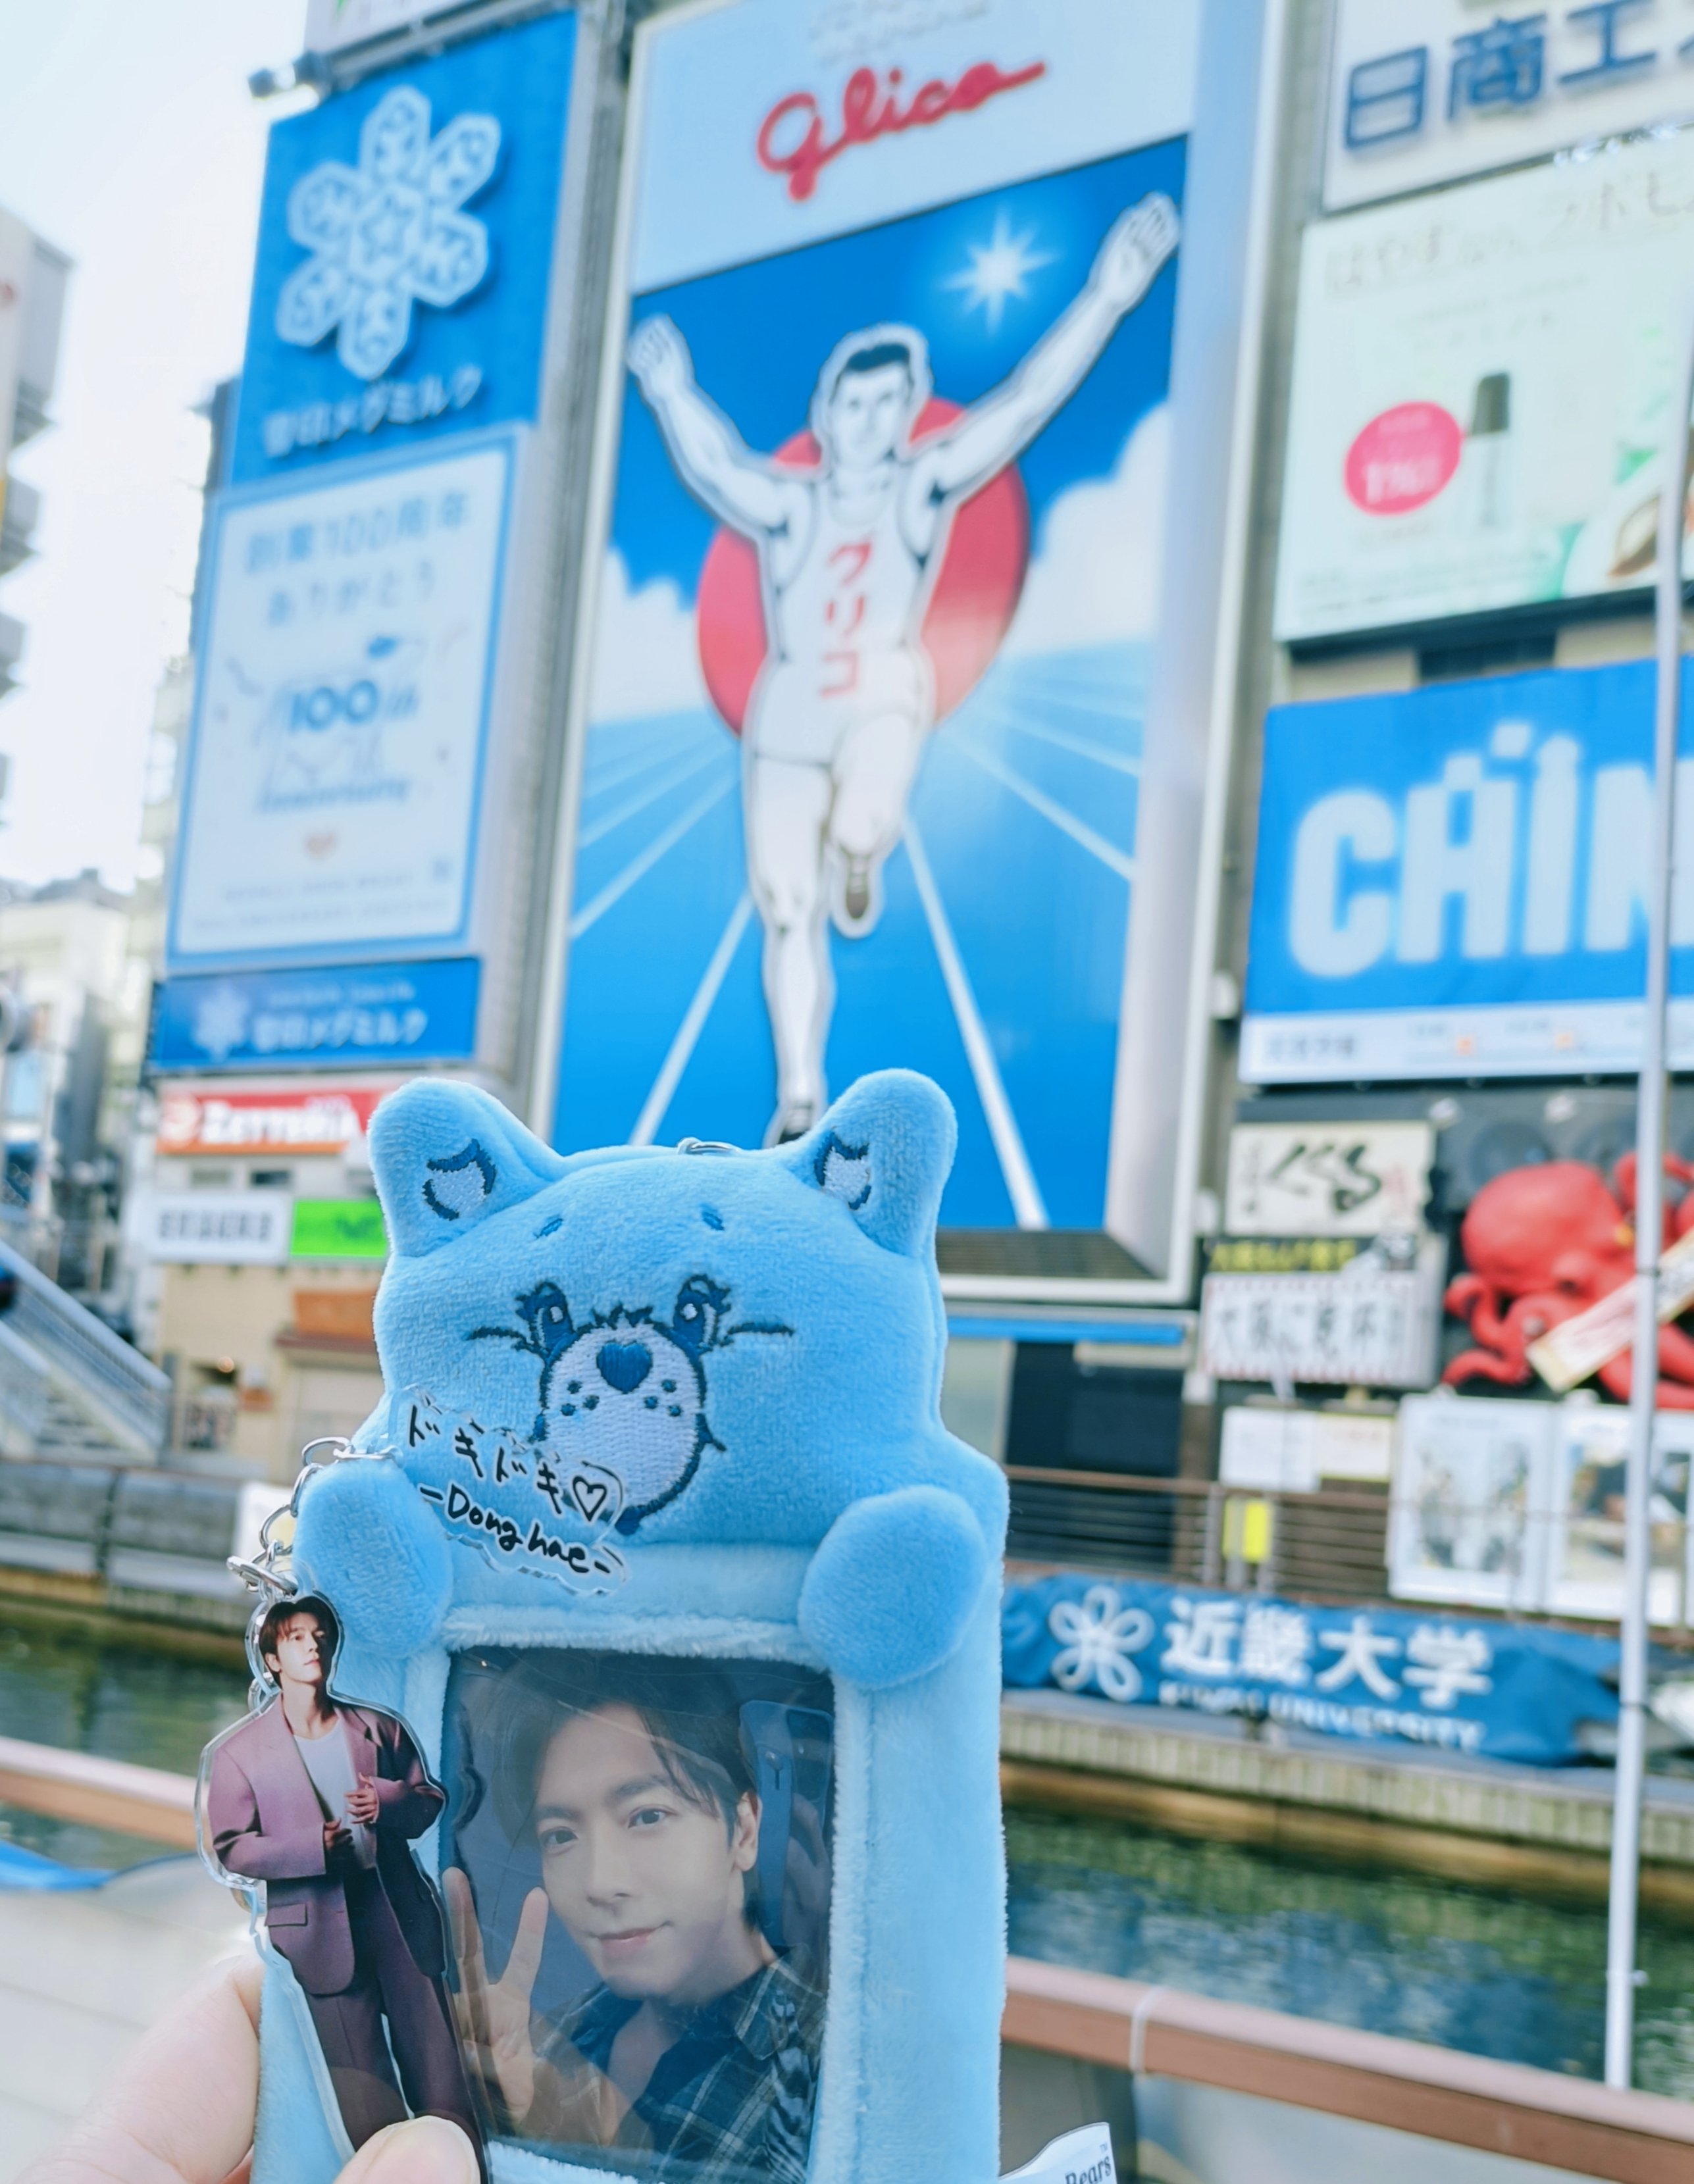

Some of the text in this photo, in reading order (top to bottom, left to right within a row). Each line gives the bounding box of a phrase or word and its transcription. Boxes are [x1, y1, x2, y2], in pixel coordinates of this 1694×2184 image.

[1344, 0, 1694, 151] 日商エ
[820, 530, 874, 698] グリコ
[1160, 1597, 1493, 1710] 近畿大学
